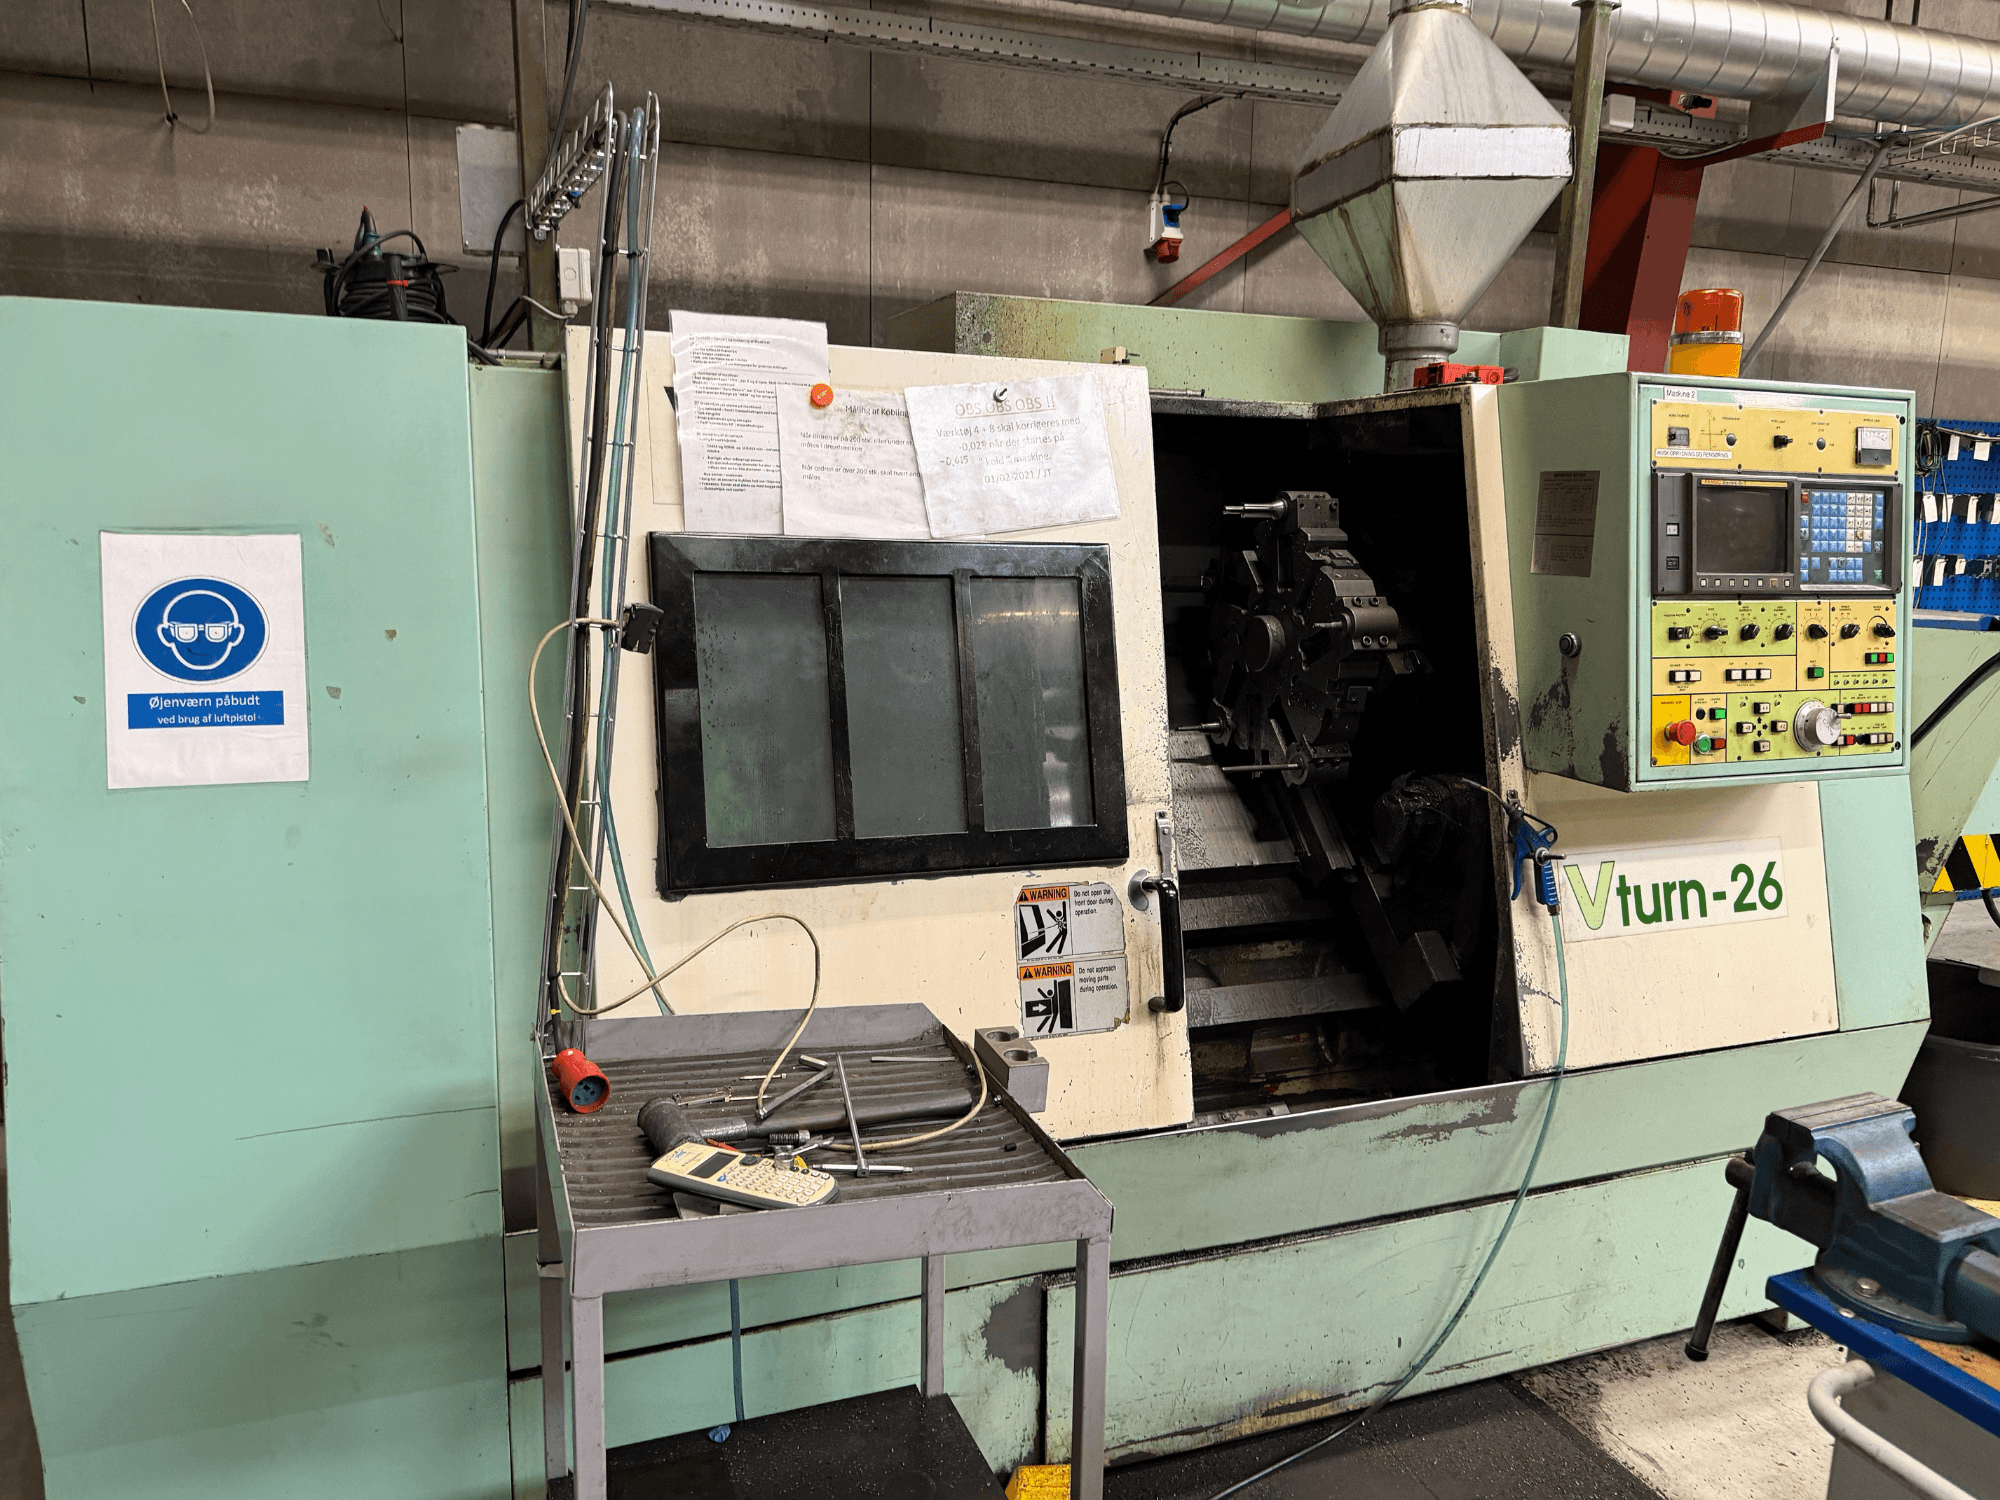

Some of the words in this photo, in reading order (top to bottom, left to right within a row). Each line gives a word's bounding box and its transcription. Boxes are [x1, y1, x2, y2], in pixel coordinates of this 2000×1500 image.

[1666, 389, 1690, 397] Maskine
[955, 402, 982, 416] OBS
[986, 400, 1012, 414] OBS
[1015, 397, 1042, 411] OBS
[936, 426, 972, 438] Værktøj
[974, 426, 979, 434] 4
[989, 424, 995, 433] 8
[997, 422, 1014, 432] skal
[1016, 419, 1059, 431] korrigeres
[1062, 416, 1080, 426] med
[988, 438, 1003, 448] når
[1006, 437, 1020, 447] der
[1023, 435, 1052, 445] startes
[1055, 432, 1065, 444] på
[1013, 453, 1052, 463] maskine.
[984, 471, 1035, 484] 01/02-2021
[1044, 468, 1051, 477] JT
[149, 695, 212, 710] Øjenværn
[215, 694, 260, 708] påbudt
[157, 714, 175, 724] ved
[178, 712, 200, 726] brug
[202, 712, 212, 723] af
[214, 712, 256, 724] luftpistol
[1029, 888, 1067, 900] WARNING
[1099, 898, 1113, 906] during
[1034, 964, 1072, 977] WARNING
[1096, 965, 1116, 974] approach
[1096, 983, 1118, 992] operation.
